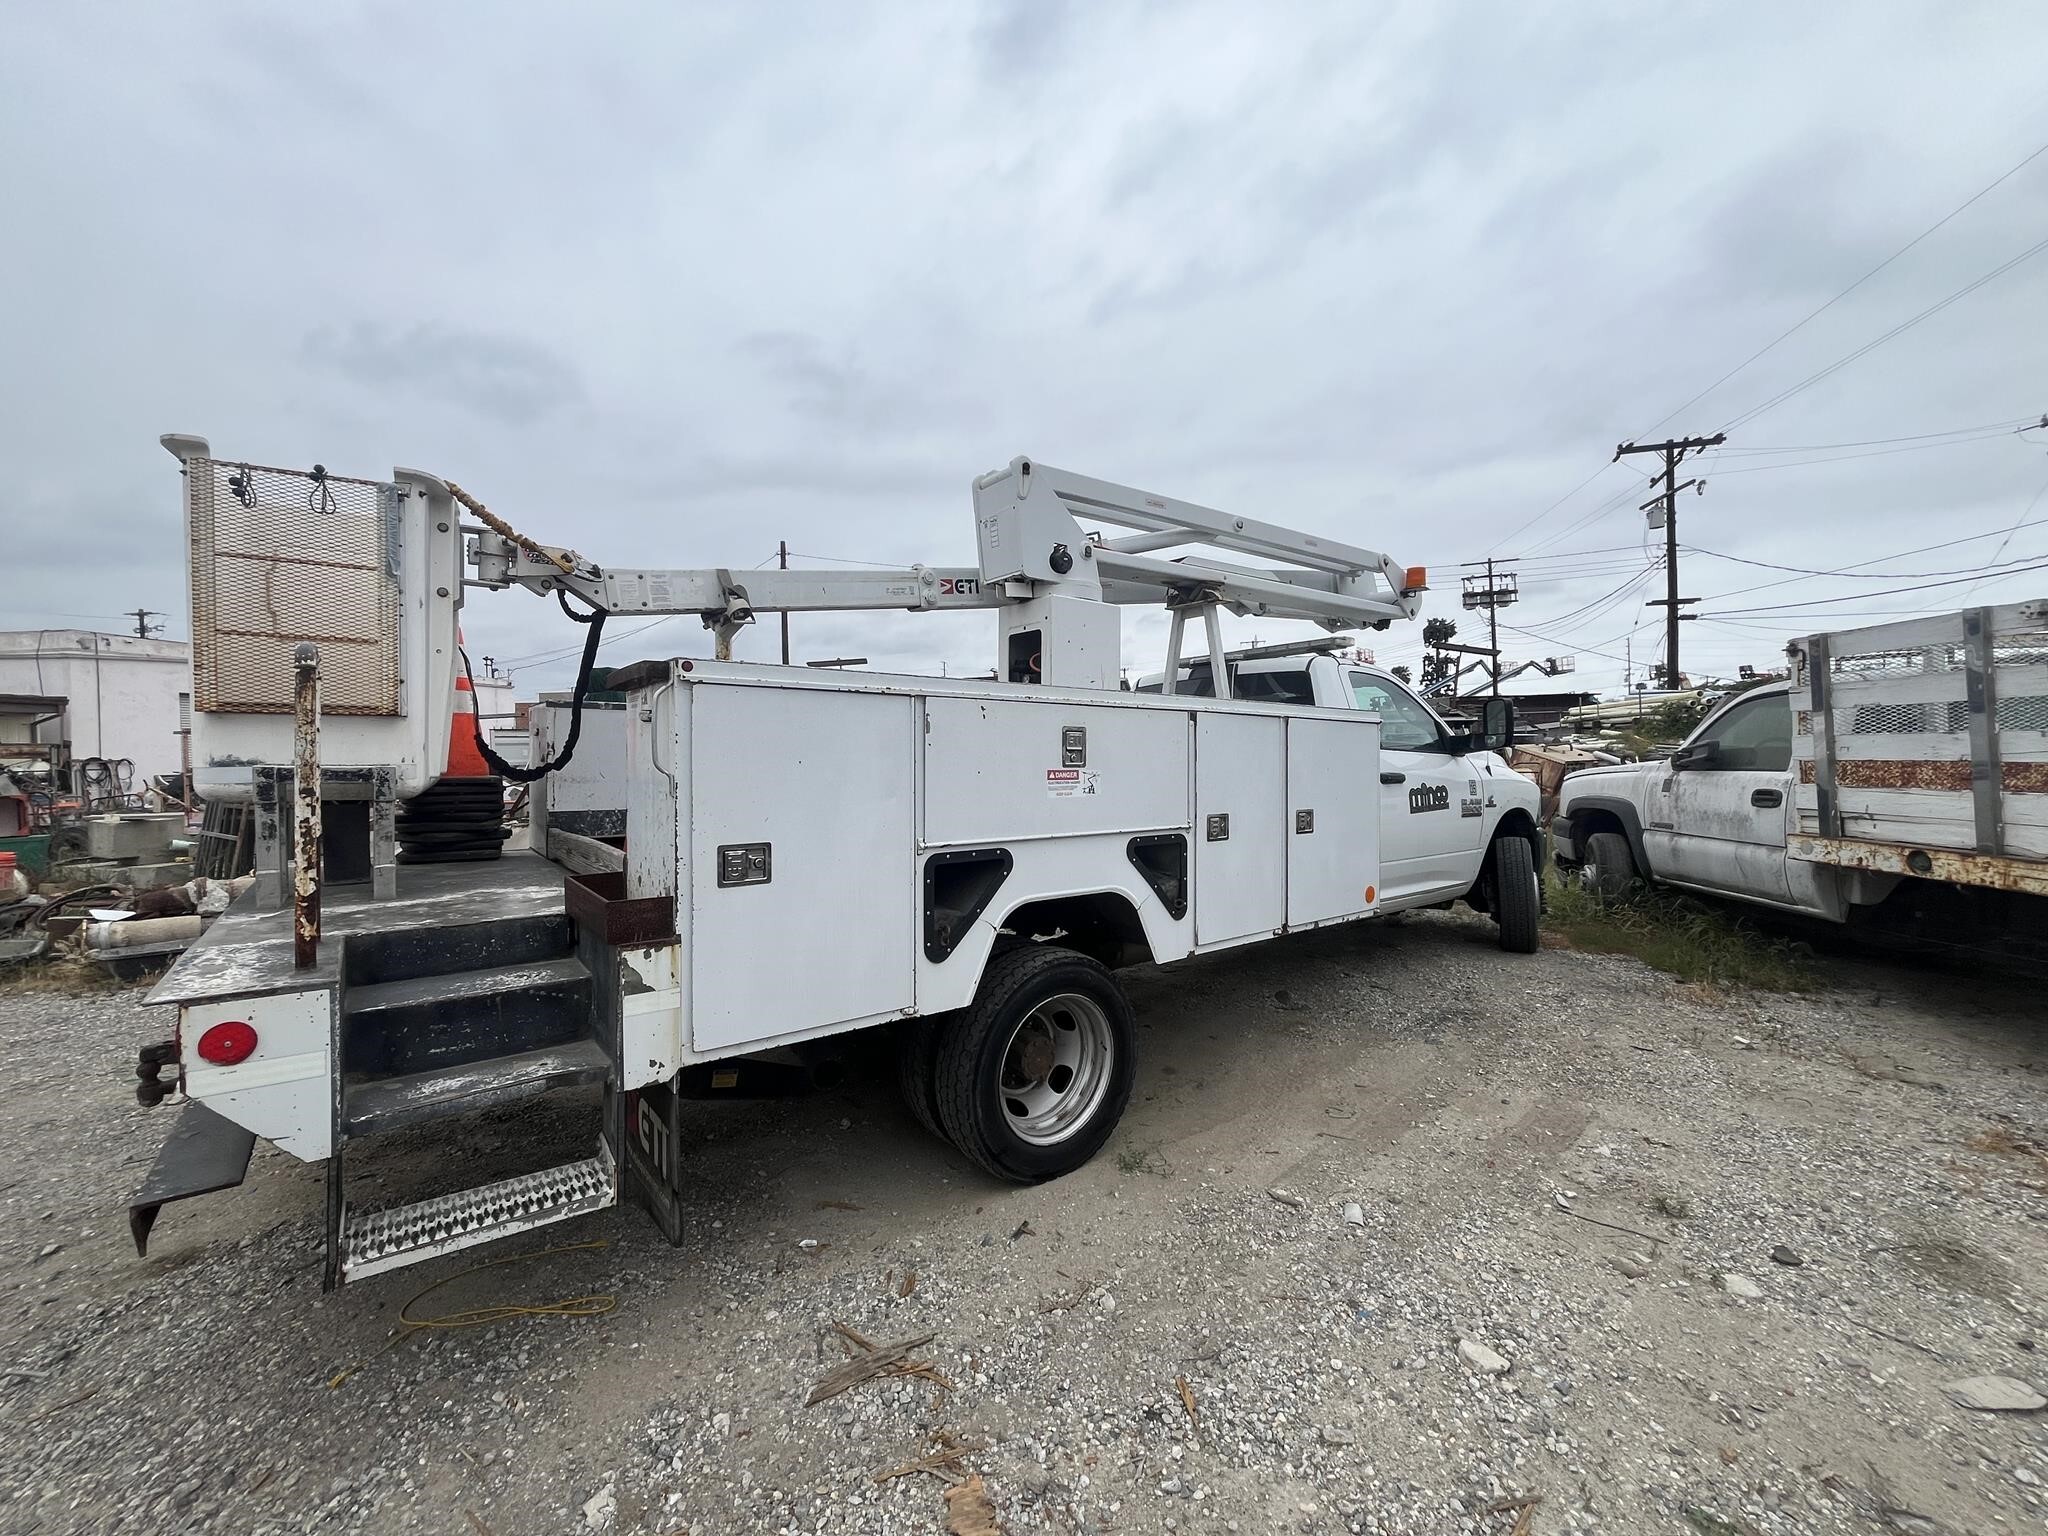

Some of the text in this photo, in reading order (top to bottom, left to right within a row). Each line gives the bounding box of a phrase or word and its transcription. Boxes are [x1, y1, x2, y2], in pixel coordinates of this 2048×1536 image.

[954, 578, 980, 595] ETI
[1055, 771, 1078, 779] DANGER
[638, 1097, 668, 1181] ETI
